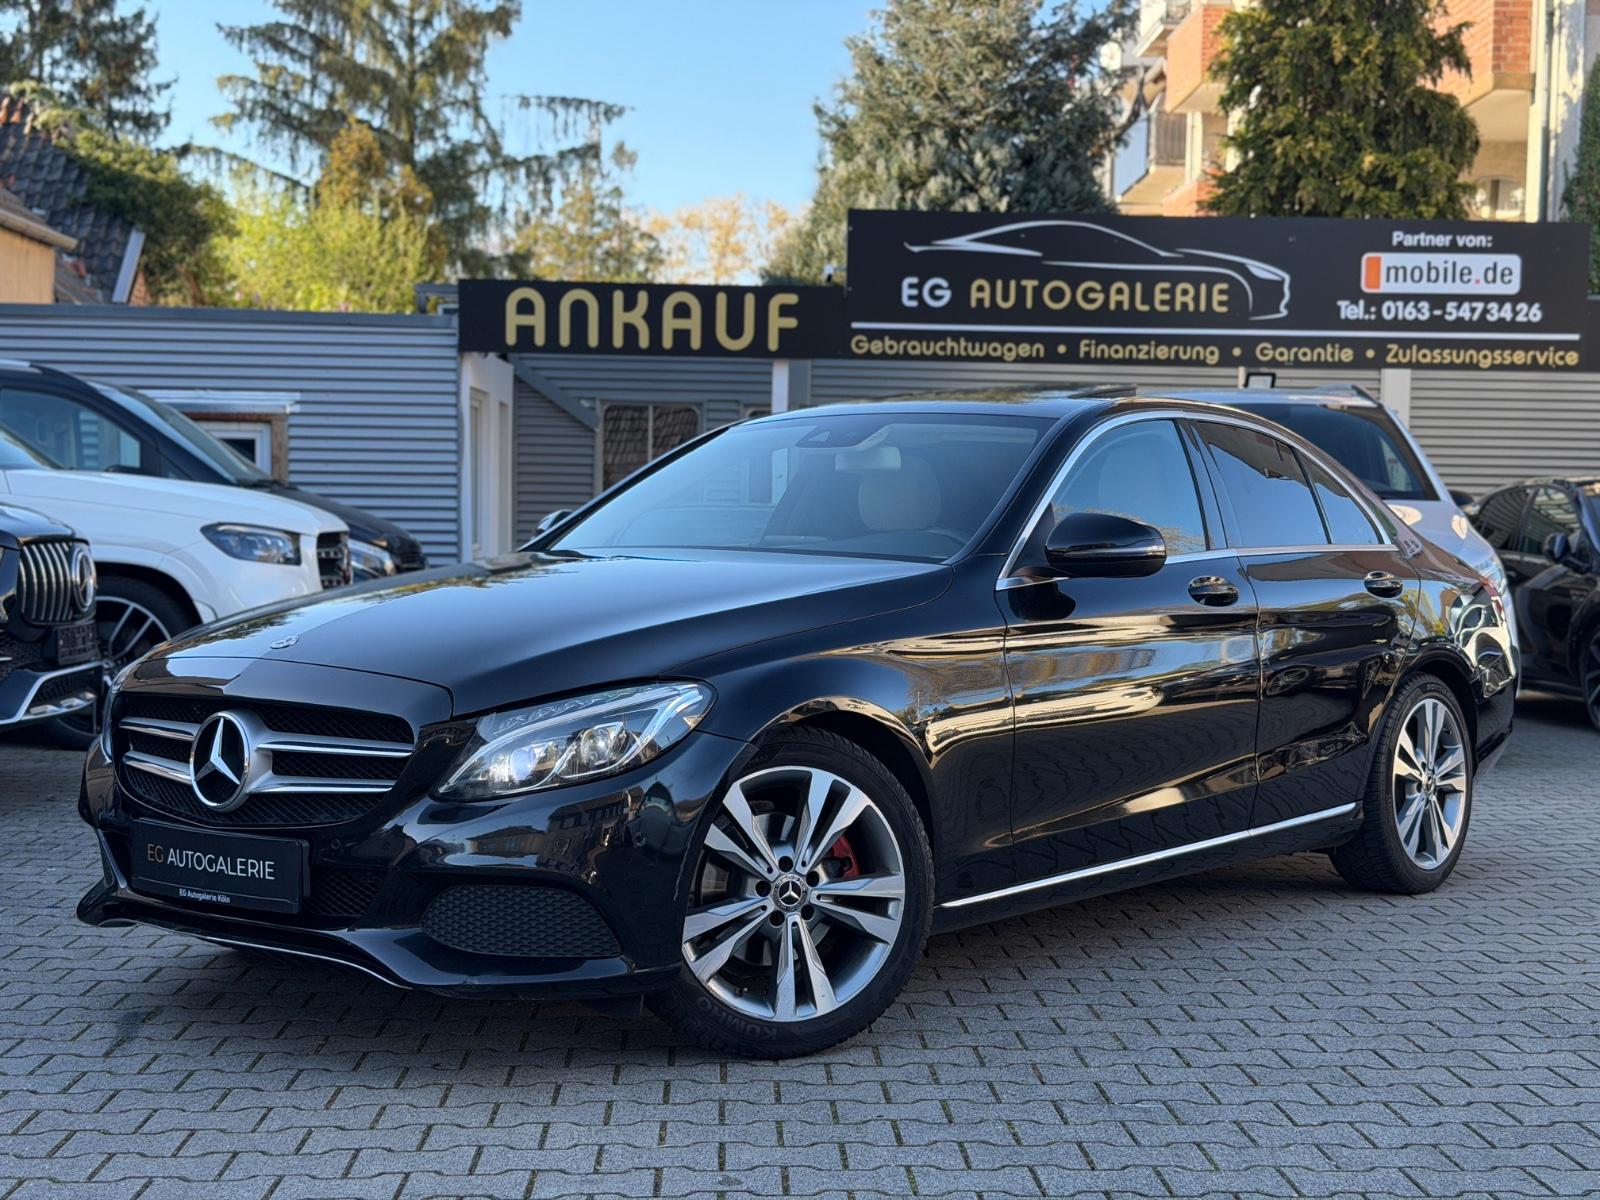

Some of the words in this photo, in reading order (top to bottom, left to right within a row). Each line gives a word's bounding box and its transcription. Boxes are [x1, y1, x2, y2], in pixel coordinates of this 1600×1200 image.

[1392, 231, 1452, 246] Partner
[1456, 233, 1493, 248] von:
[1386, 260, 1514, 285] mobile.de
[901, 277, 952, 308] EG
[969, 279, 1230, 313] AUTOGALERIE
[504, 287, 799, 352] ANKAUF
[1337, 300, 1377, 320] Tel.:
[850, 335, 1045, 362] Gebrauchtwagen
[1079, 340, 1220, 365] Finanzierung
[1255, 342, 1354, 363] Garantie
[1385, 344, 1580, 369] Zulassungsservice
[147, 844, 164, 863] EG
[167, 848, 275, 880] AUTOGALERIE
[179, 888, 187, 896] EG
[187, 890, 217, 901] Autogalerie
